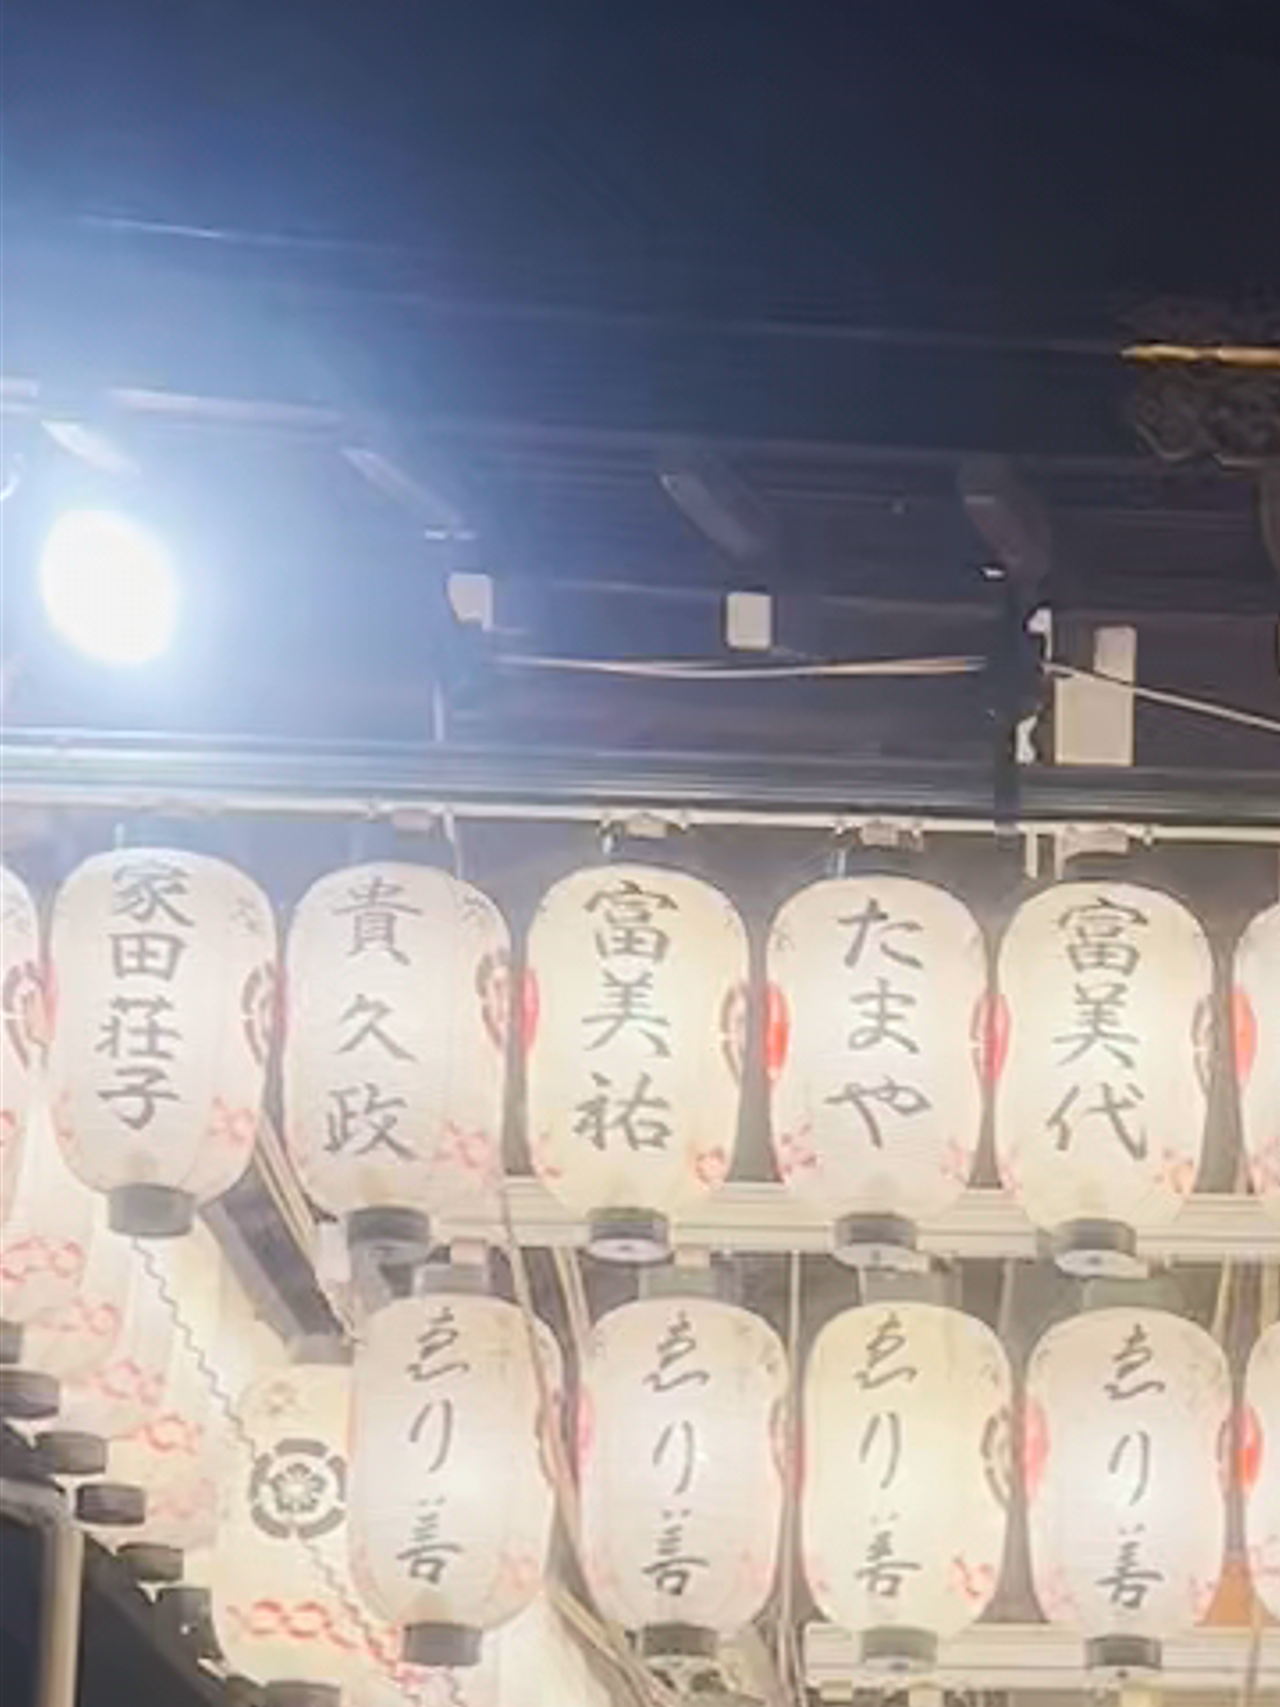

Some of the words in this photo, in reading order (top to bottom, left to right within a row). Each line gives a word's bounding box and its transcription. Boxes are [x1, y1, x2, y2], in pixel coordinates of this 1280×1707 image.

[322, 876, 422, 1162] 貴久政
[574, 880, 679, 1152] 富美祐
[823, 897, 933, 1148] たまや
[1046, 896, 1149, 1161] 富美代
[396, 1305, 469, 1586] ゑり善
[642, 1314, 712, 1599] ゑり善
[854, 1314, 922, 1599] ゑり善
[1096, 1323, 1164, 1611] ゑり善
